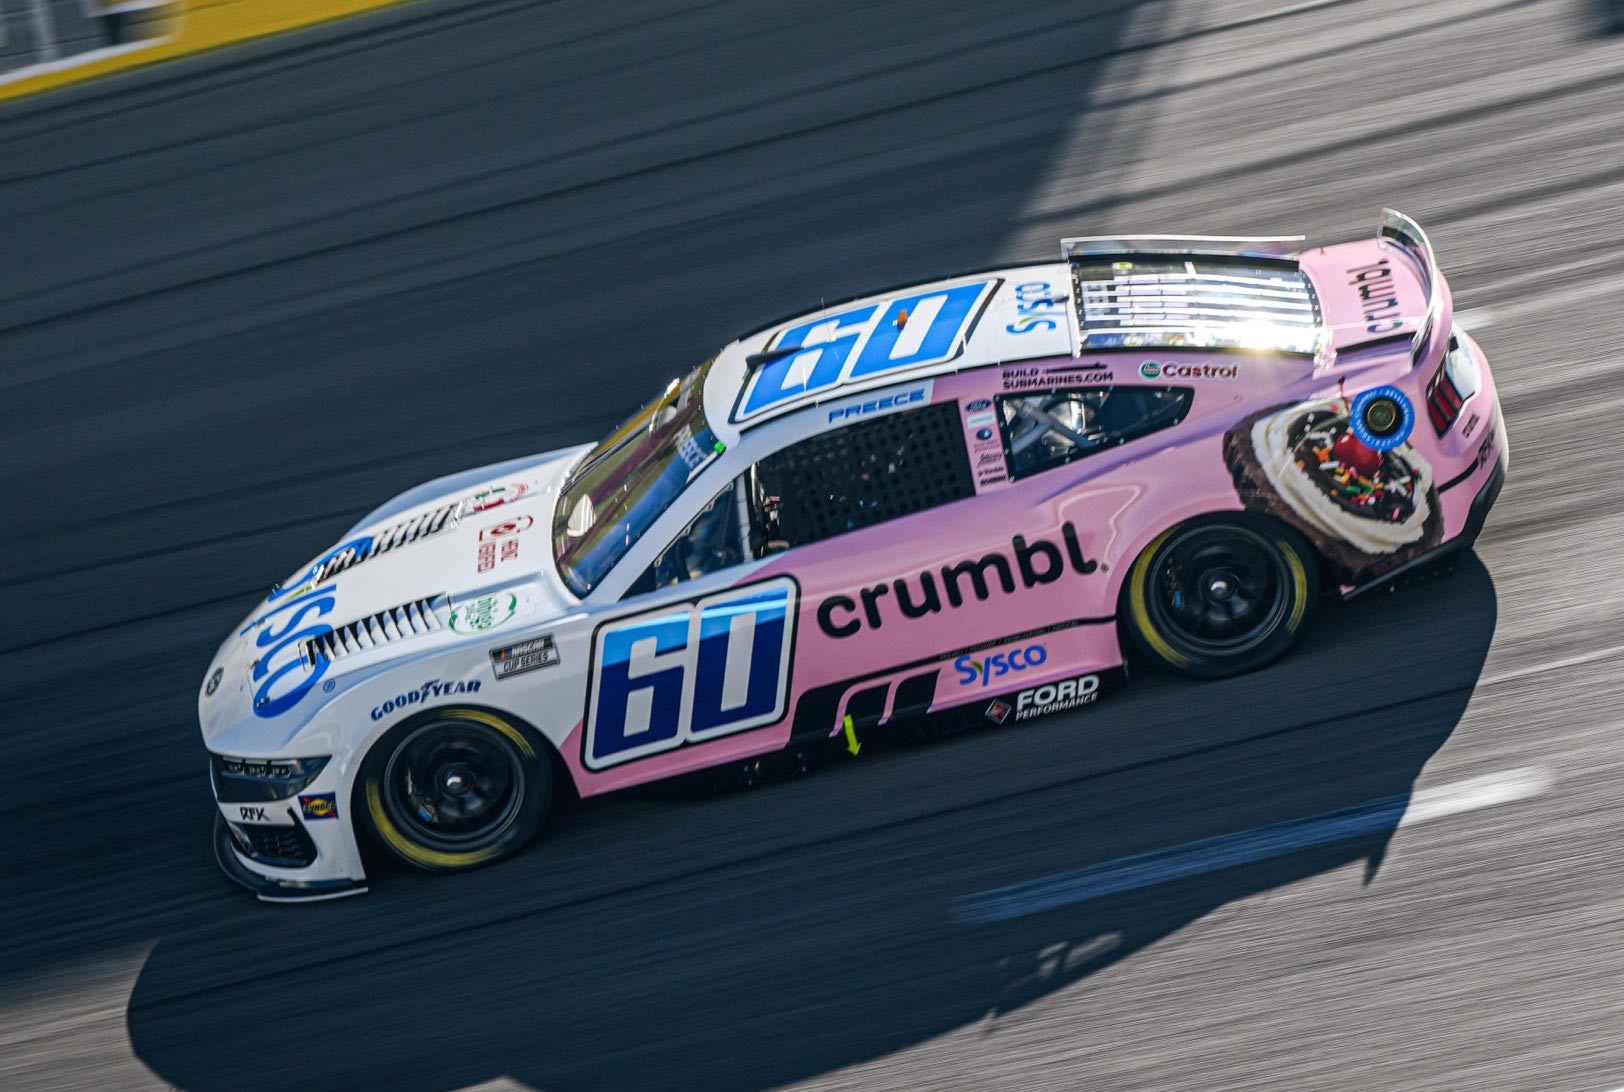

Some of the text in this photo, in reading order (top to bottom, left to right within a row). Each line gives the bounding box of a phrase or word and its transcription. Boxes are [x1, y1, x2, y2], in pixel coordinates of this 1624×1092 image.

[1346, 258, 1404, 333] crumbl
[742, 281, 989, 416] 60
[1003, 367, 1040, 381] BUILD
[1003, 371, 1114, 390] SUBMARINES.COM
[1162, 363, 1238, 379] Castrol
[828, 388, 926, 425] PREECE
[816, 521, 1098, 639] crumbl
[503, 651, 548, 672] CUP SERIES
[512, 638, 545, 657] NASCAR
[954, 644, 1048, 687] Sysco
[591, 585, 789, 760] 60
[370, 678, 482, 722] GOODYEAR
[1015, 692, 1098, 721] PERFORMANCE
[1016, 675, 1100, 711] FORD
